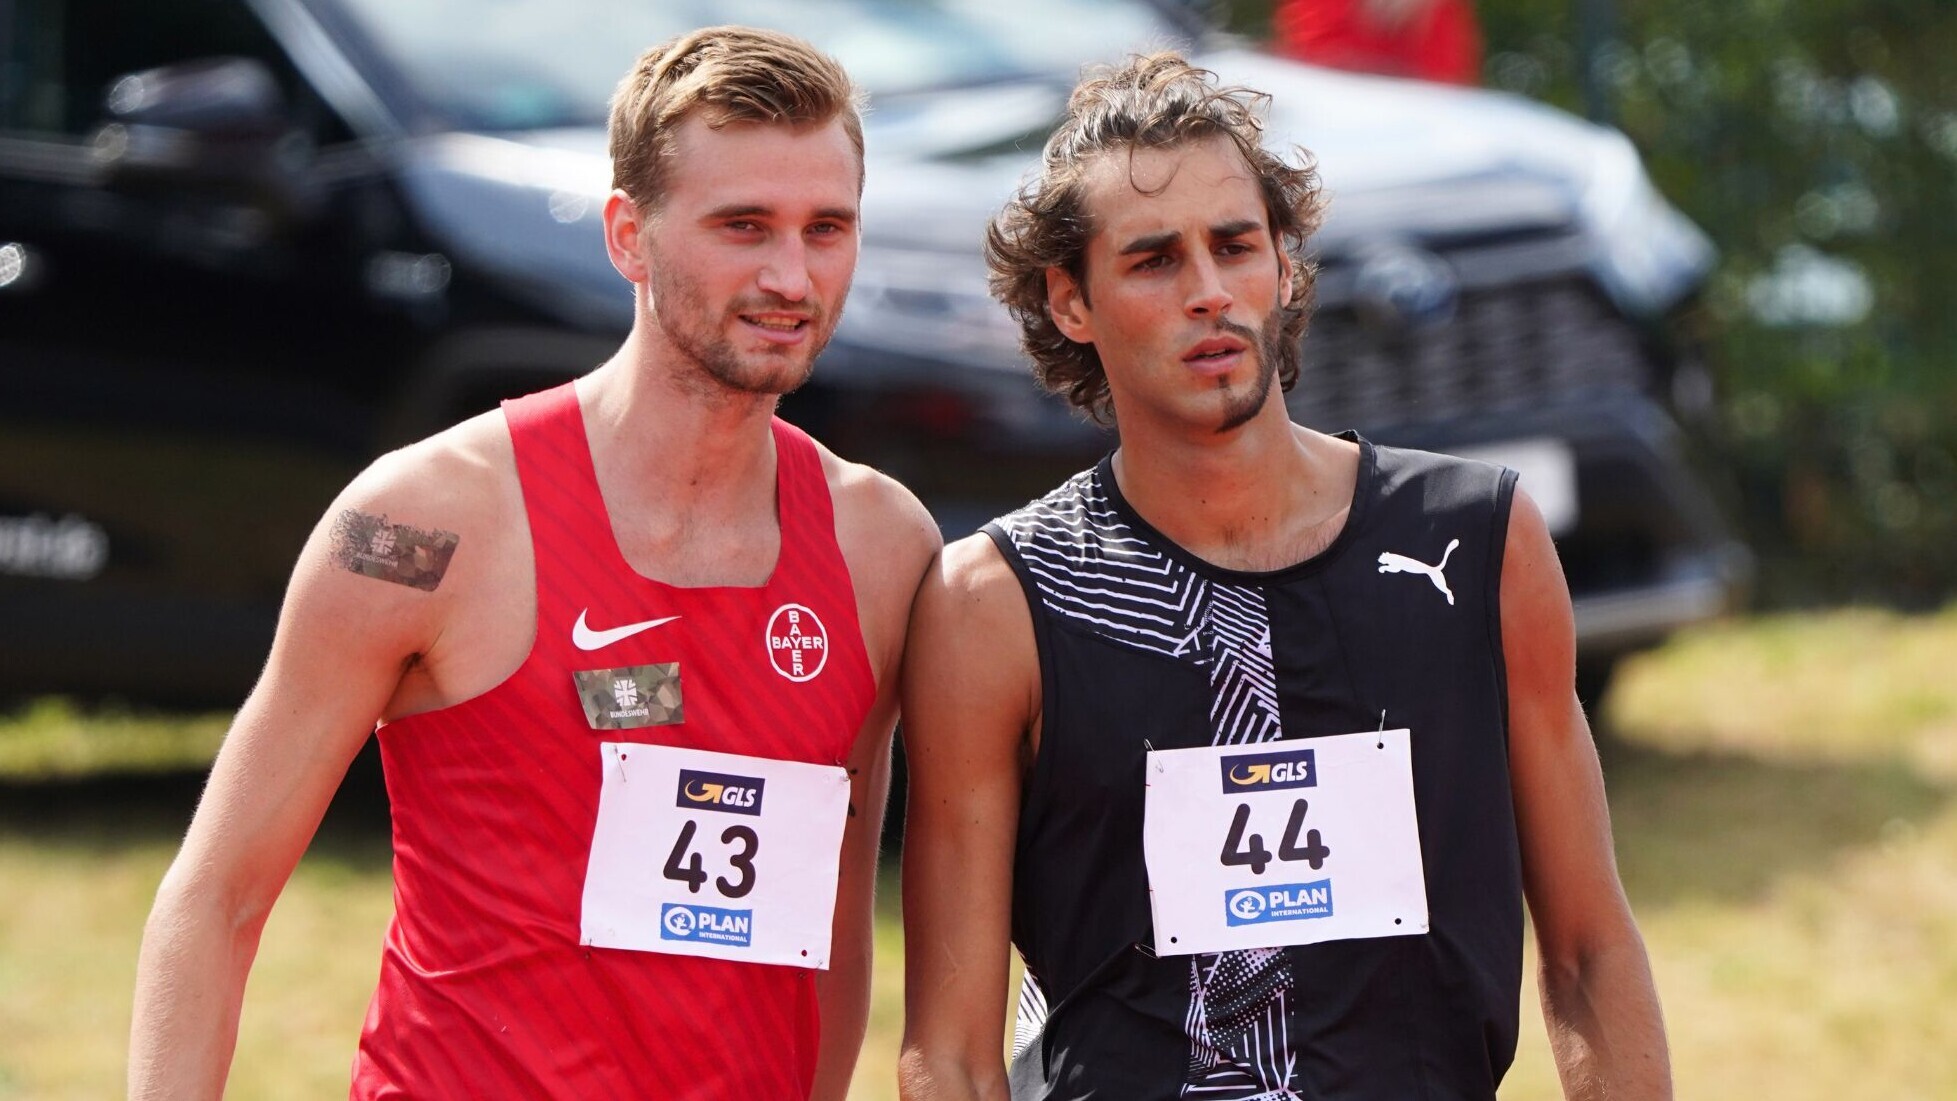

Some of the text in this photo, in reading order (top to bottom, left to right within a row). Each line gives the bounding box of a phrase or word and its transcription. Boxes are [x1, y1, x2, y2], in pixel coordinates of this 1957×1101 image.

[771, 636, 823, 650] BAYER
[1271, 761, 1308, 783] GLS
[721, 786, 757, 808] GLS
[1220, 798, 1331, 875] 44
[663, 820, 759, 899] 43
[1269, 887, 1328, 908] PLAN
[698, 911, 749, 934] PLAN
[1271, 906, 1329, 917] INTERNATIONAL
[698, 931, 748, 943] INTERNATIONAL
